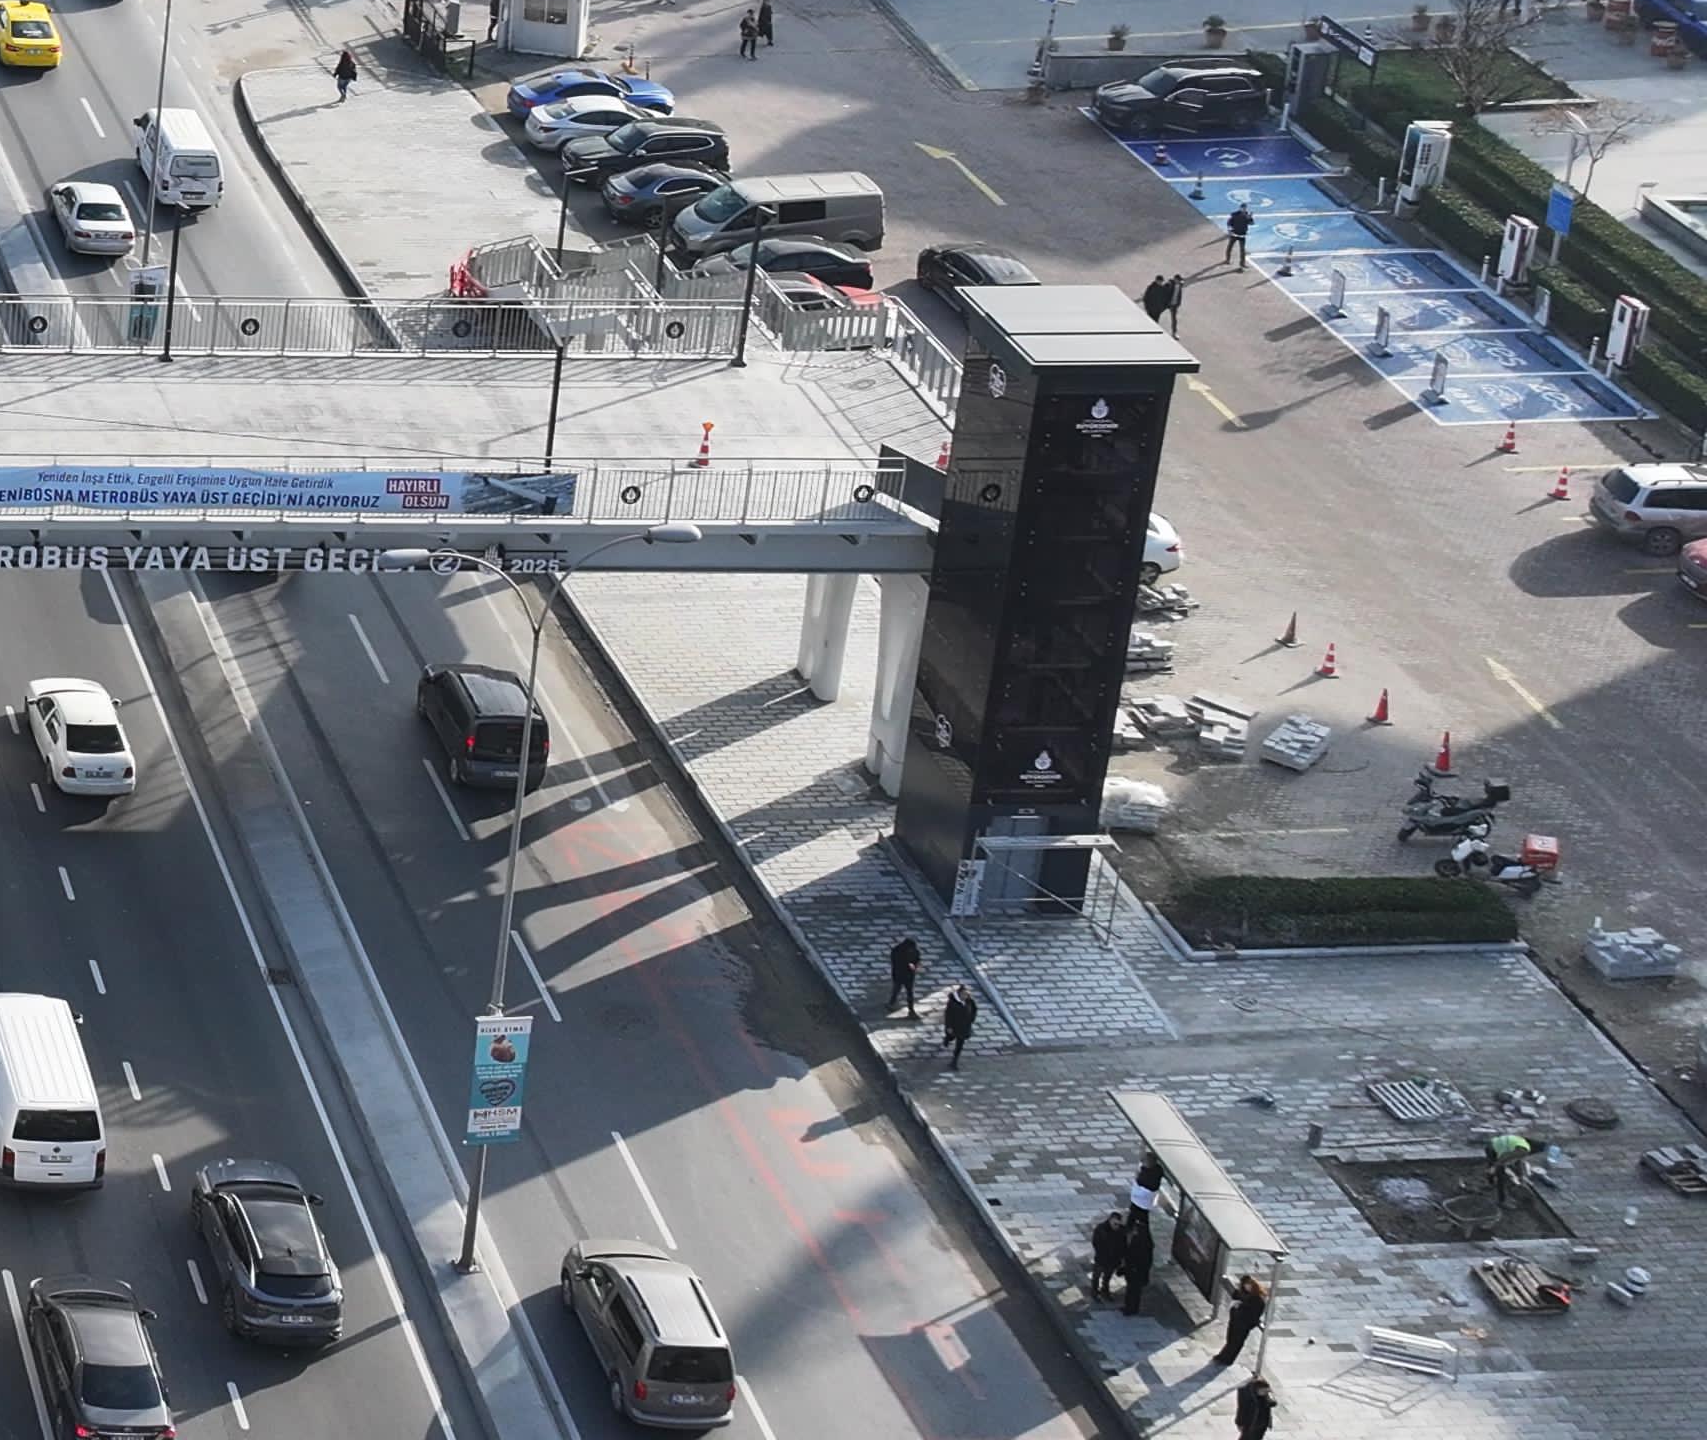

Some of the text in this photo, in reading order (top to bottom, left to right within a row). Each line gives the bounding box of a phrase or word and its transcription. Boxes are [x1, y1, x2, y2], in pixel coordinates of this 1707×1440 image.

[37, 471, 334, 489] Yeniden İnşa Ettik, Engelli Erişimine Uygun Hale Getirdik
[388, 479, 438, 493] HAYIRLI
[77, 489, 158, 504] METROBÜS
[162, 491, 197, 505] YAYA
[200, 489, 229, 505] ÜST
[232, 490, 303, 507] GEÇİDİ'Nİ
[306, 495, 380, 509] AÇIYORUZ
[404, 495, 447, 509] OLSUN
[123, 547, 212, 571] YAYA
[226, 547, 292, 572] ÜST
[303, 548, 416, 575] GEÇİ
[511, 559, 559, 574] 2025
